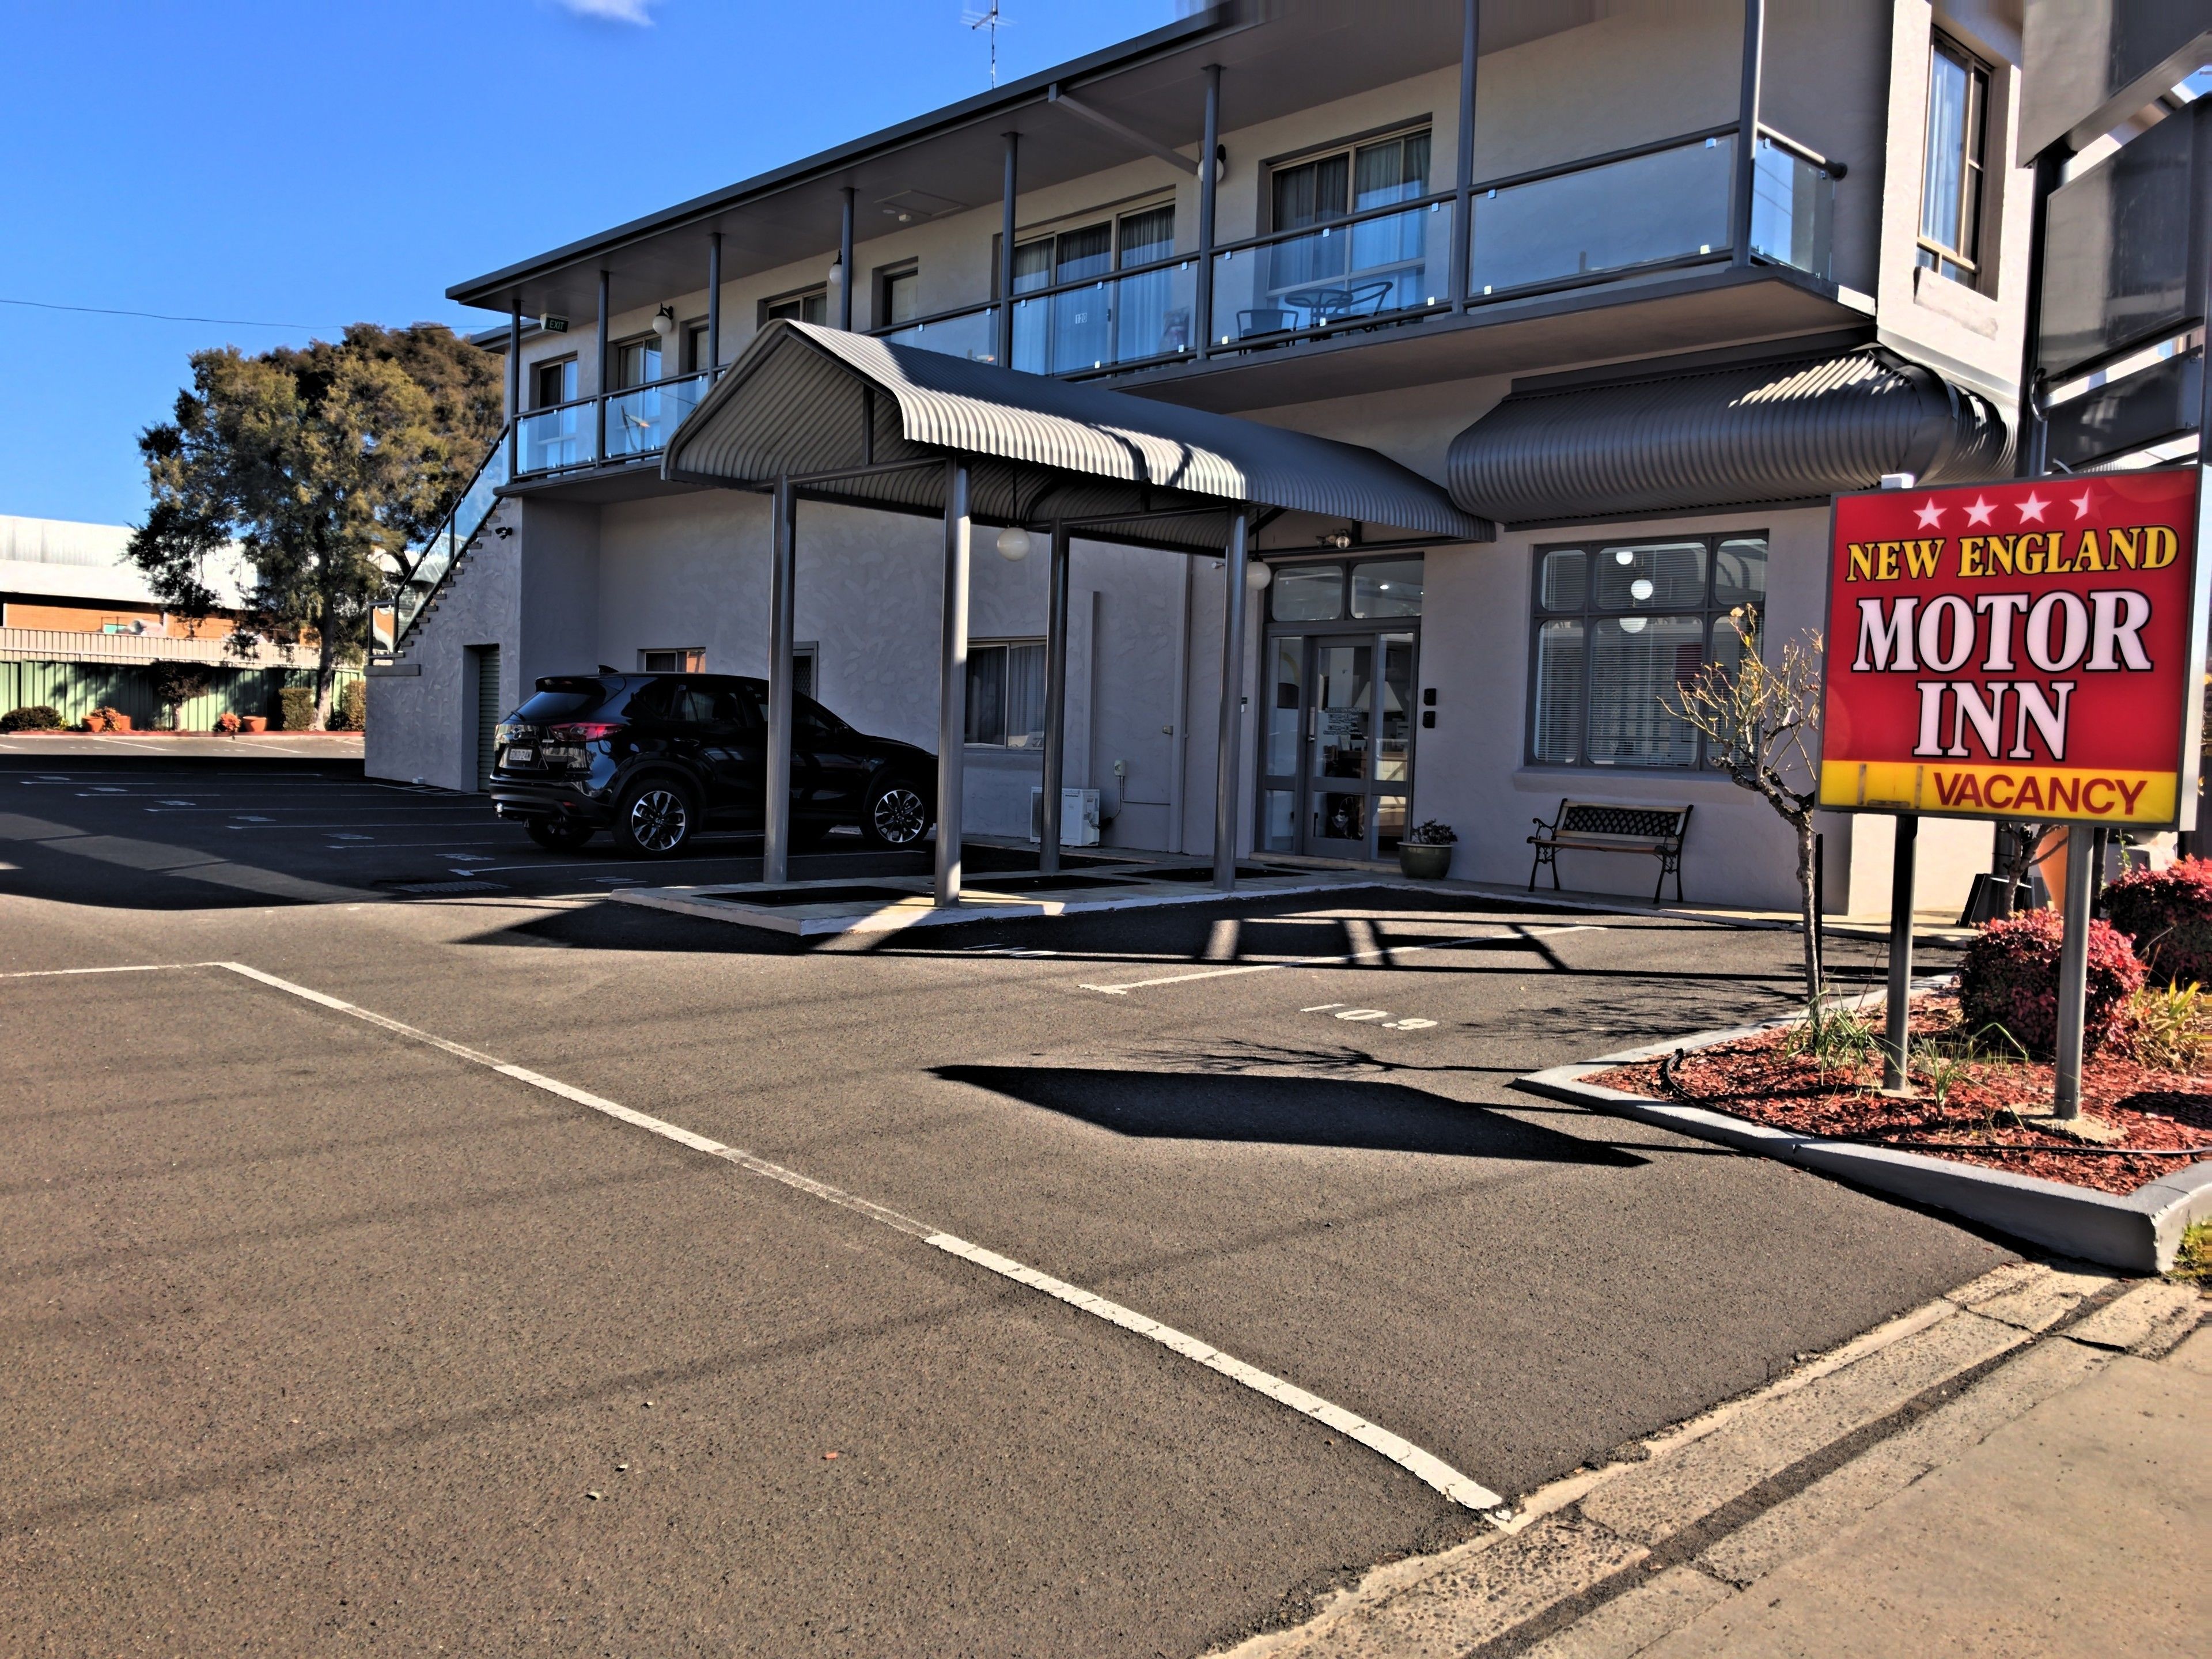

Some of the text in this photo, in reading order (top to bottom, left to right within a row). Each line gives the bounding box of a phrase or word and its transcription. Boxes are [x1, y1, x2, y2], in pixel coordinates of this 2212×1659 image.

[549, 320, 565, 330] EXIT
[1076, 313, 1087, 324] 120
[1846, 524, 2180, 582] NEW ENGLAND
[1851, 588, 2154, 673] MOTOR
[1912, 680, 2077, 762] INN
[1933, 772, 2147, 816] VACANCY
